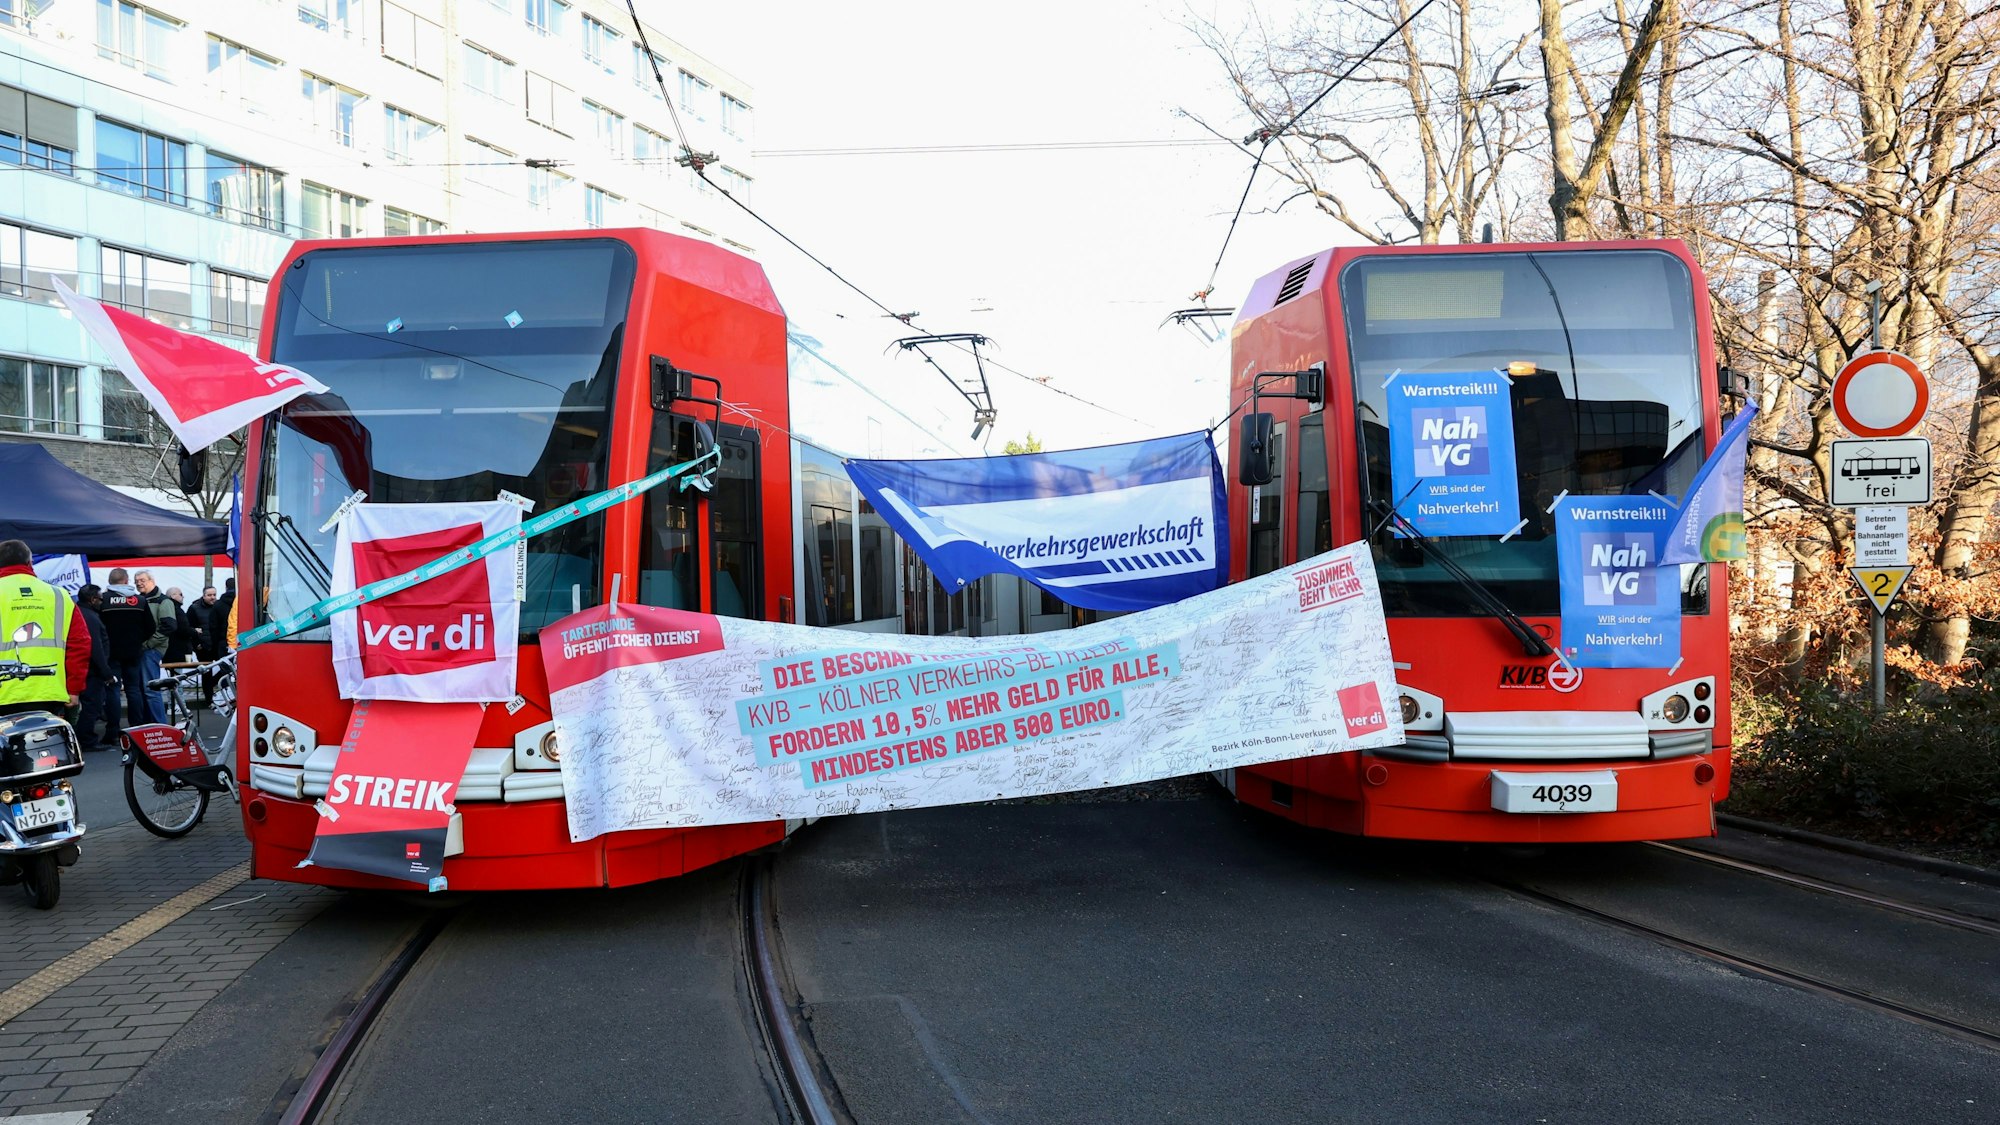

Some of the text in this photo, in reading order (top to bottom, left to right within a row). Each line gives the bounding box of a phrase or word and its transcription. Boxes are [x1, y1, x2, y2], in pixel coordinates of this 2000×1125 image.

[1402, 382, 1498, 397] Warnstreik!!!
[1421, 415, 1479, 441] Nah
[1431, 443, 1472, 467] VG
[1429, 484, 1486, 495] WIR sind der
[1866, 484, 1896, 498] frei
[1418, 501, 1499, 516] Nahverkehr!
[1571, 506, 1667, 521] Warnstreik!!!
[1865, 515, 1896, 523] Betreten
[1857, 532, 1904, 541] Bahnanlagen
[1590, 542, 1647, 568] Nah
[1864, 548, 1897, 557] gestattet
[1295, 561, 1356, 593] ZUSAMMEN
[1600, 571, 1640, 596] VG
[1873, 573, 1889, 597] 2
[110, 596, 126, 604] KVB
[1299, 577, 1364, 608] GEHT MEHR
[561, 617, 636, 643] TARIFRUNDE
[1597, 614, 1652, 625] WIR sind der
[363, 613, 486, 653] ver.di
[1585, 632, 1663, 646] Nahverkehr!
[563, 630, 700, 660] ÖFFENTLICHER DIENST
[748, 699, 792, 729] KVB
[818, 677, 902, 715] KÖLNER
[907, 640, 1130, 697] VERKEHRS-BETRIEBE
[773, 661, 817, 690] DIE
[1500, 665, 1547, 685] KVB
[768, 653, 1169, 758] FORDERN 10,5% MEHR GELD FÜR ALLE,
[1347, 711, 1383, 728] ver.di
[811, 698, 1120, 784] MINDESTENS ABER 500 EURO.
[1212, 727, 1337, 754] Bezirk Köln-Bonn-Leverkusen
[329, 773, 454, 812] STREIK
[1532, 784, 1593, 804] 4039
[31, 802, 41, 813] L
[1558, 801, 1565, 811] 2
